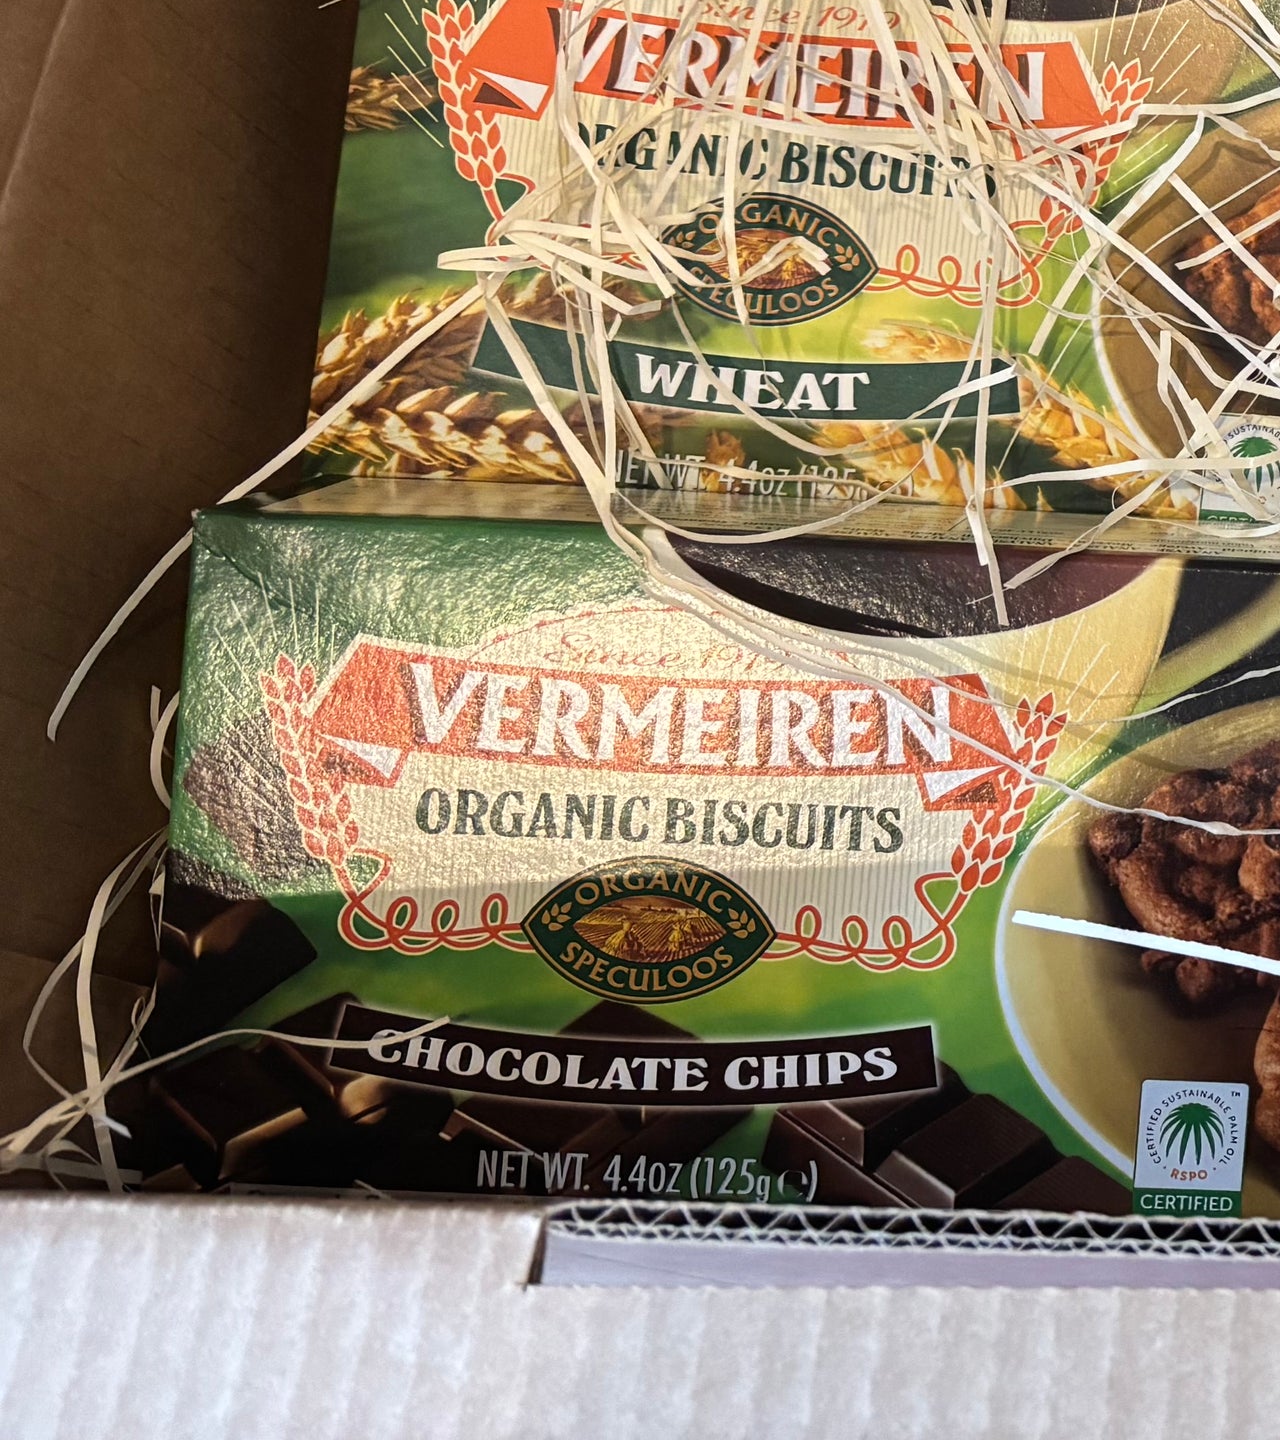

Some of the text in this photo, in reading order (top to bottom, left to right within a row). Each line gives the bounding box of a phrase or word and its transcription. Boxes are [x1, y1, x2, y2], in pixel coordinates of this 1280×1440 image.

[634, 354, 870, 412] WHEAT
[407, 662, 954, 769] VERMEIREN
[415, 787, 907, 854] ORGANIC BISCUITS
[574, 865, 731, 921] ORGANIC
[558, 941, 737, 992] SPECULOOS
[366, 1029, 899, 1090] CHOCOLATE CHIPS
[1148, 1089, 1238, 1165] CERTIFIED SUSTAINABLE PALM OIL
[477, 1150, 534, 1188] NET
[543, 1153, 591, 1190] WT.
[1141, 1194, 1233, 1212] CERTIFIED
